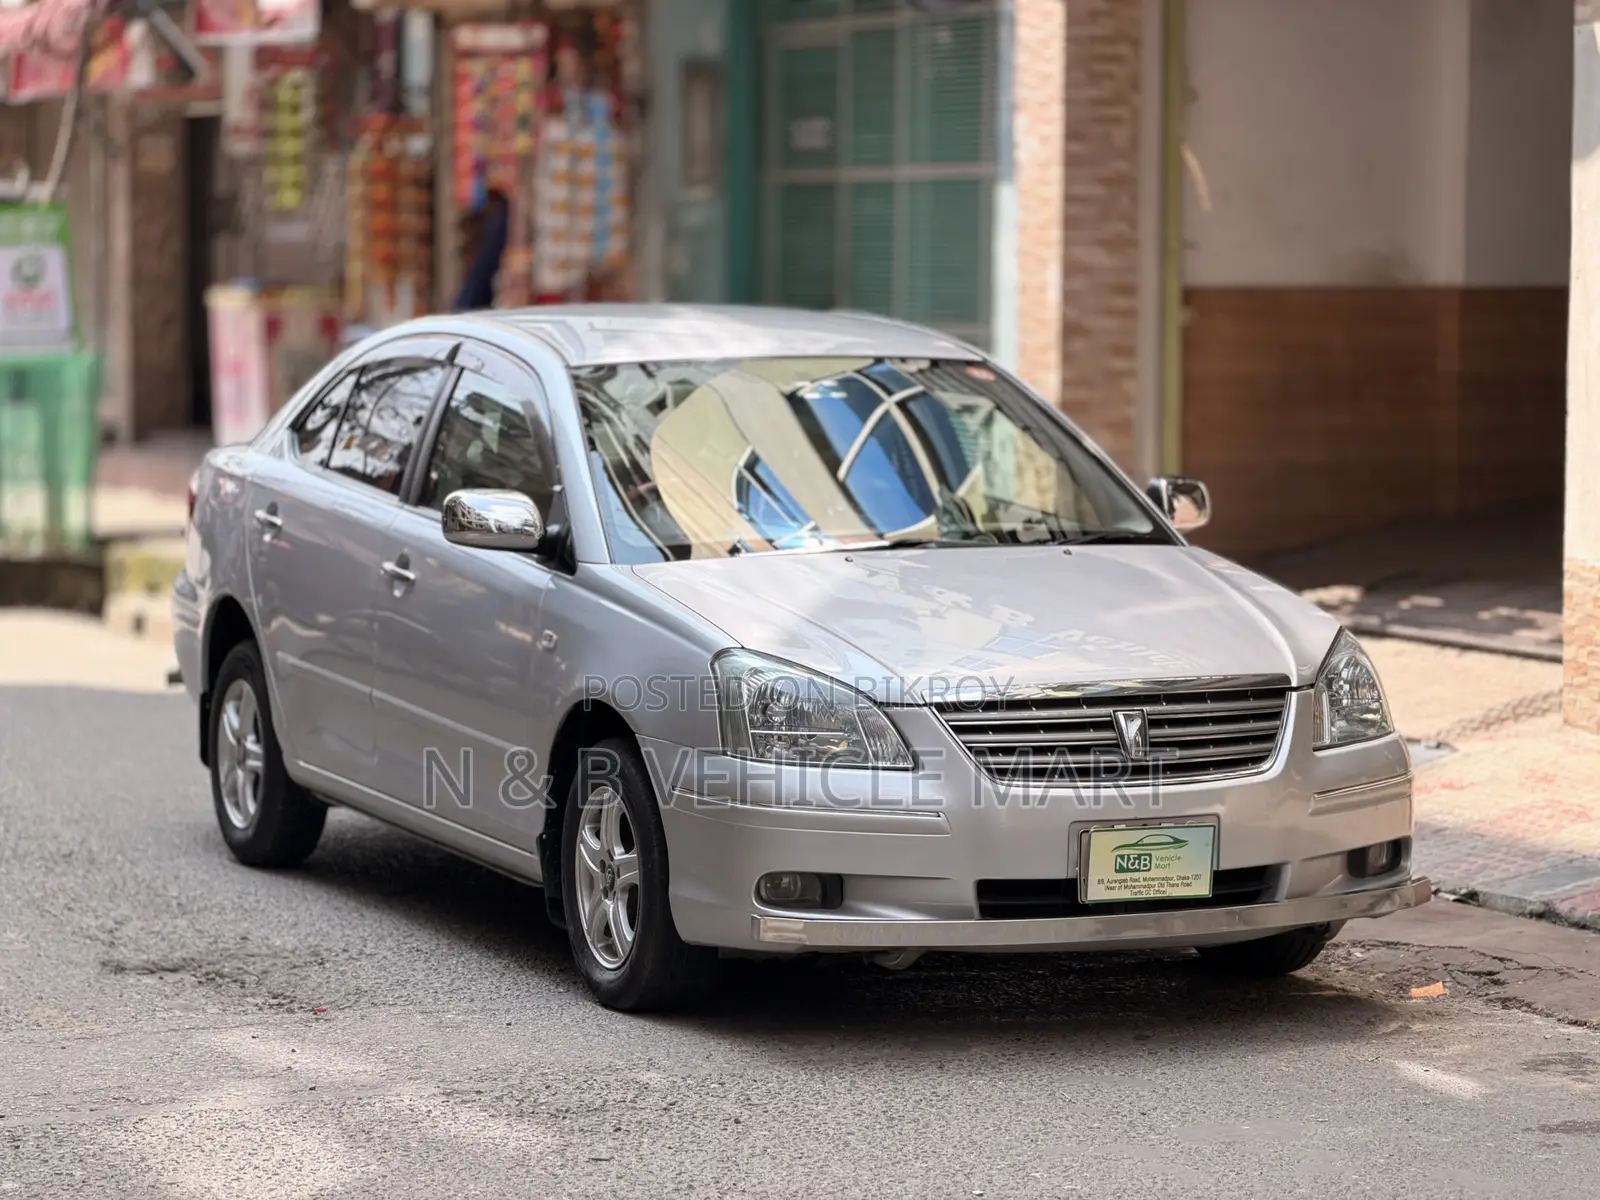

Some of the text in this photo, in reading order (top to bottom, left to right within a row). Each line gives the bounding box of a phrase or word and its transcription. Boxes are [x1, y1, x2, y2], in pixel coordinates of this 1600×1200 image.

[1155, 854, 1182, 862] Vehicle
[1116, 855, 1150, 870] N&B
[1154, 862, 1171, 870] Mart
